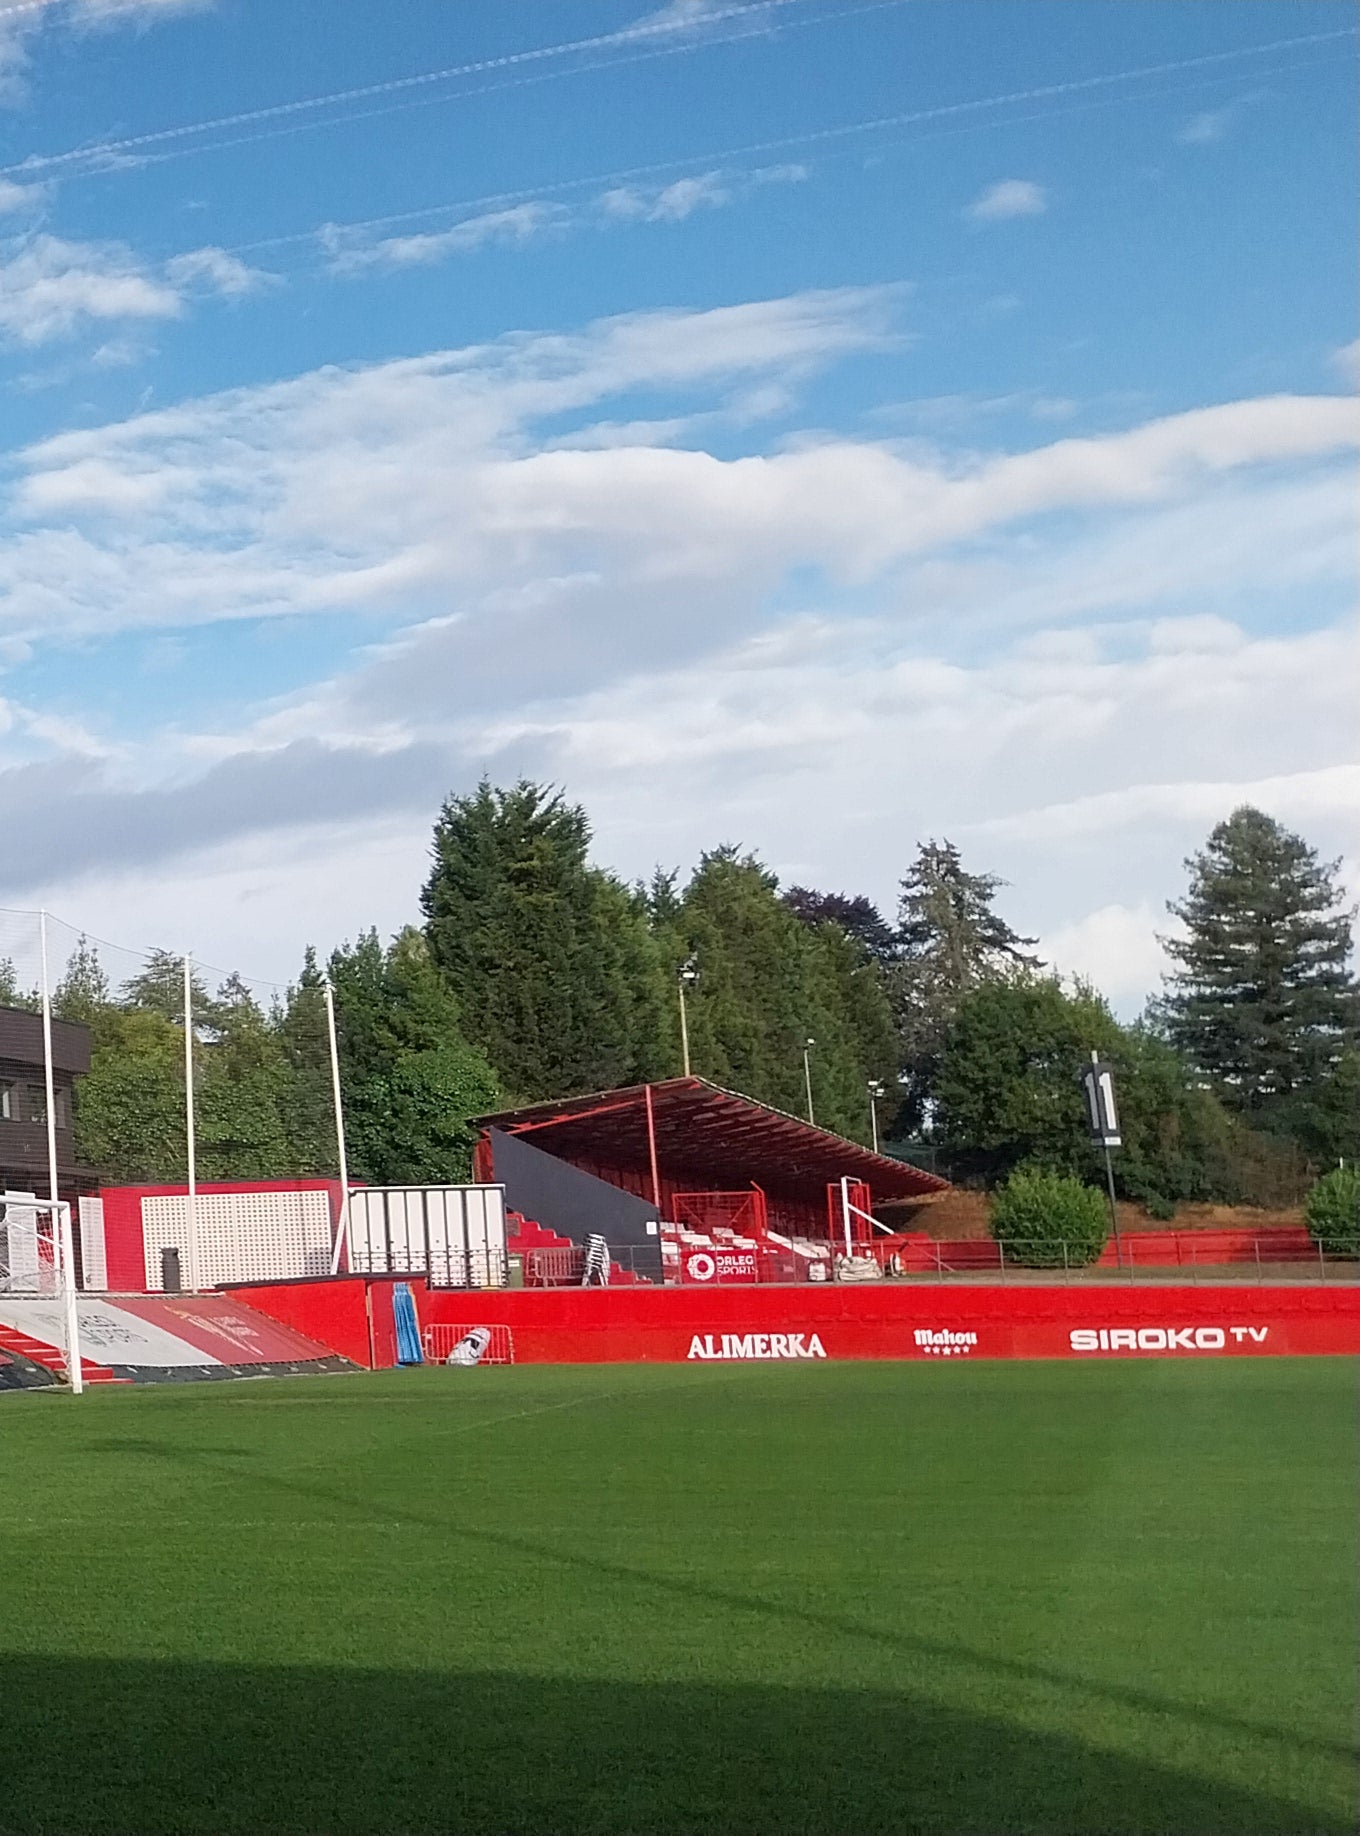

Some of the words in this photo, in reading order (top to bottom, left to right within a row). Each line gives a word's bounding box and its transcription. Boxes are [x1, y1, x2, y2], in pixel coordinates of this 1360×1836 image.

[717, 1255, 755, 1266] ORLEG
[688, 1334, 827, 1359] ALIMERKA
[913, 1328, 978, 1346] Mahou
[1070, 1328, 1226, 1351] SIROKO
[1230, 1327, 1269, 1342] TV
